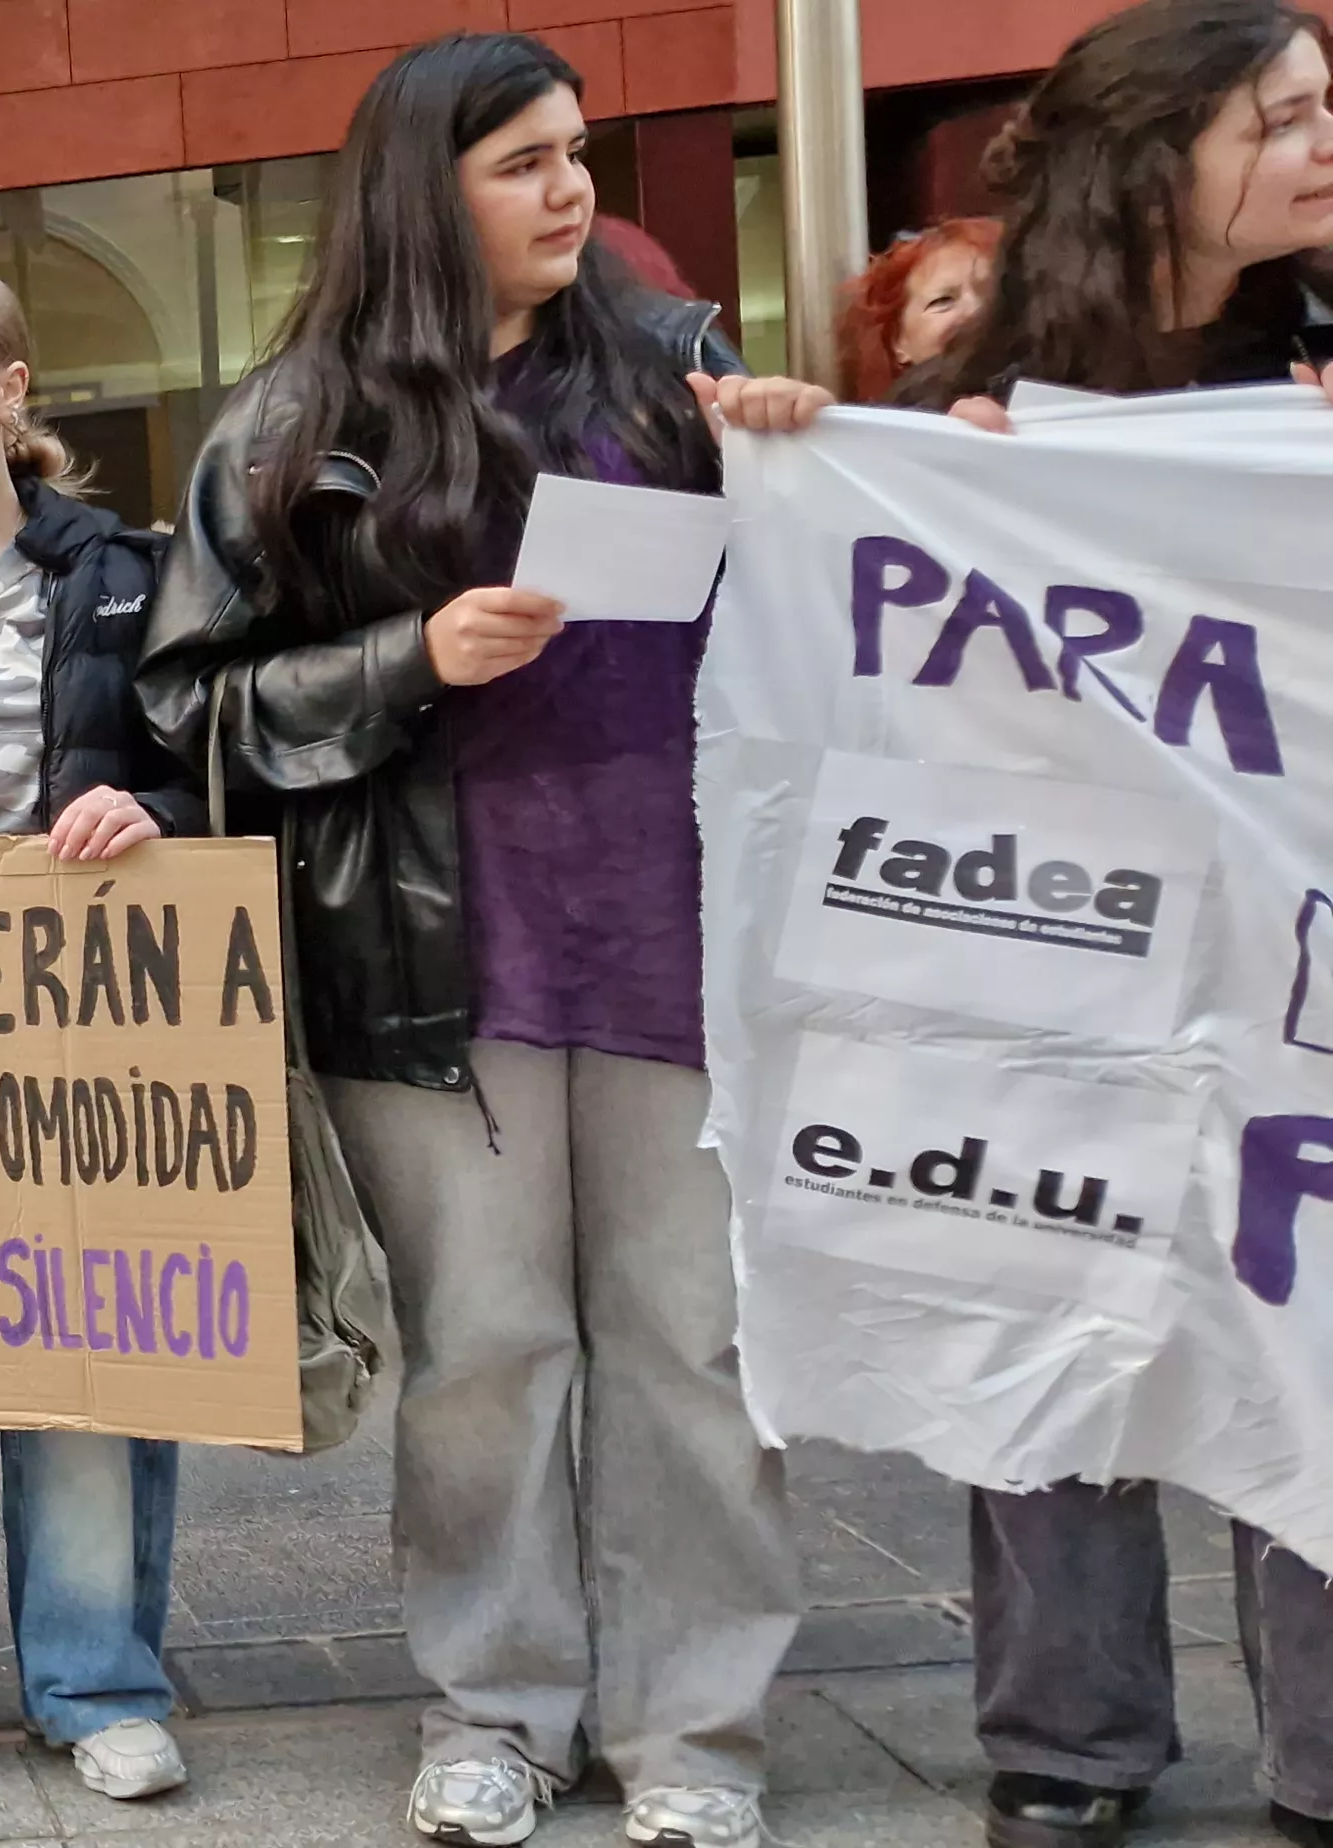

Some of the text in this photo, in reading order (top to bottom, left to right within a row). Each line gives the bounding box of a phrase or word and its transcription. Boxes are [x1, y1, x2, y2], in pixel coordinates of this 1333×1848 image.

[851, 535, 1285, 776] PARA
[832, 816, 1163, 928] fadea
[219, 905, 275, 1026] A
[785, 1174, 881, 1203] estudiantes
[887, 1195, 908, 1208] en
[913, 1198, 980, 1219] defensa
[985, 1211, 1007, 1224] de
[1013, 1214, 1029, 1228] la
[791, 1124, 1144, 1234] e.d.u.
